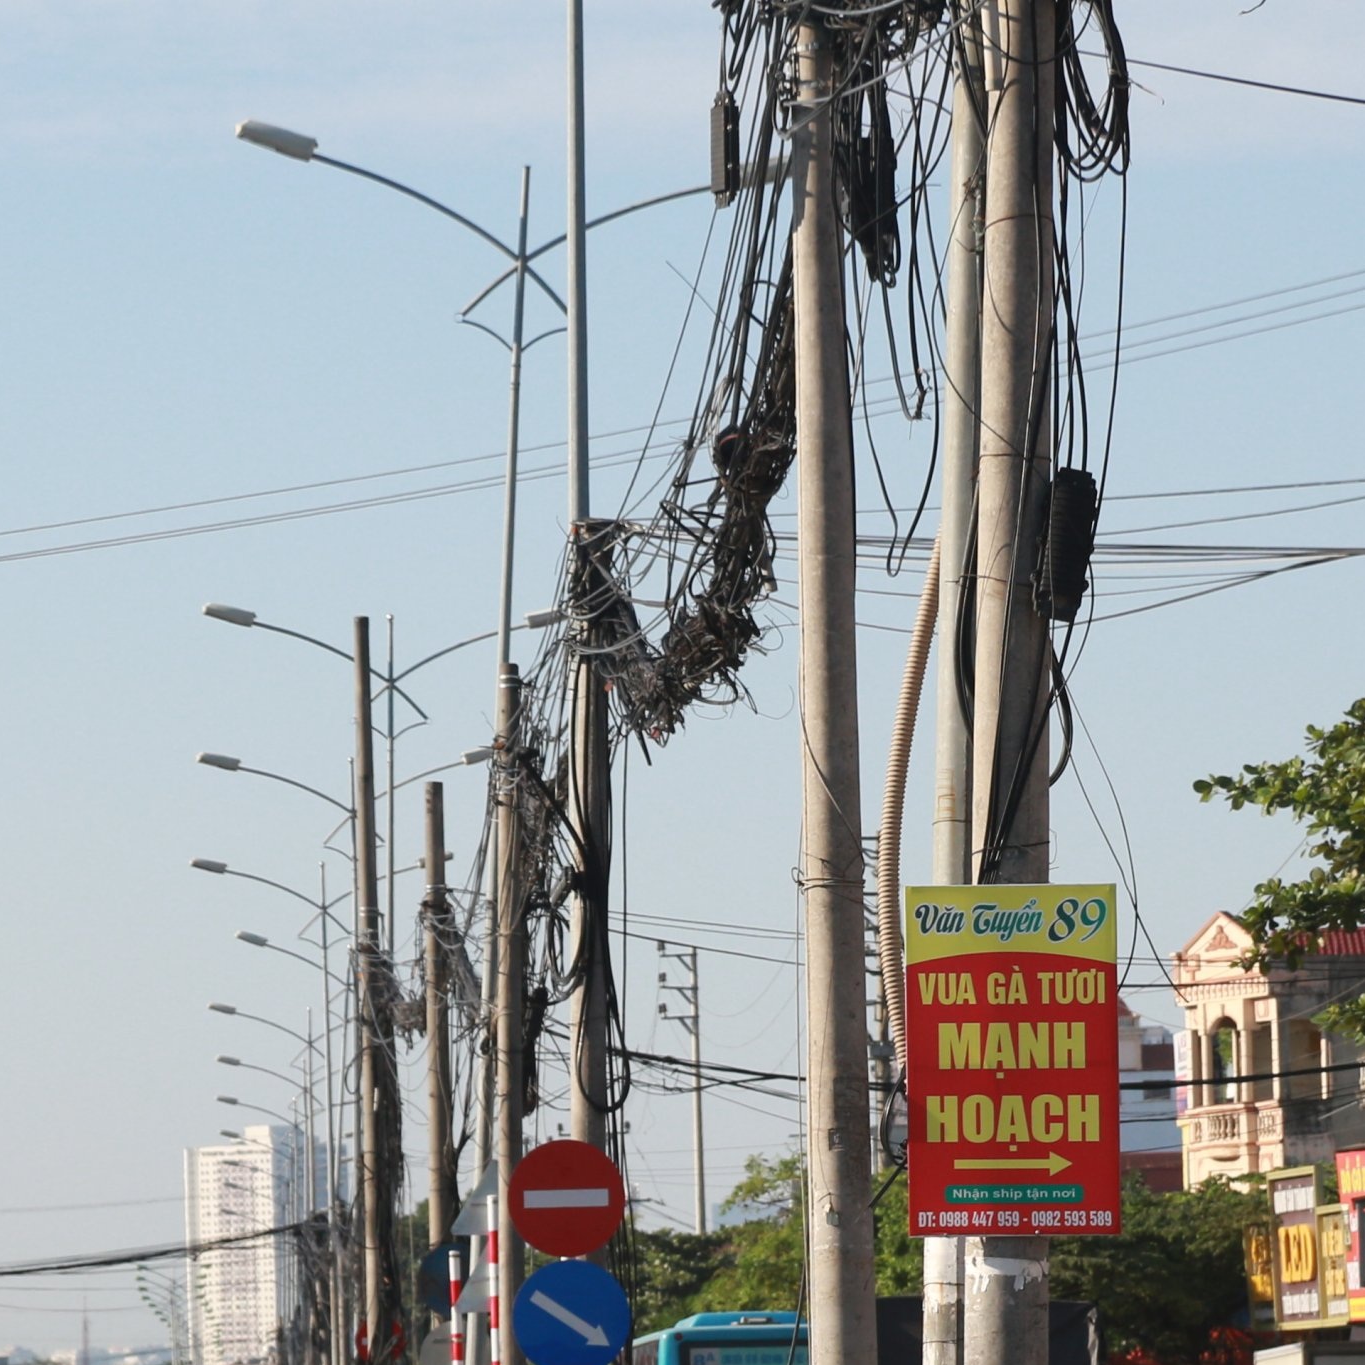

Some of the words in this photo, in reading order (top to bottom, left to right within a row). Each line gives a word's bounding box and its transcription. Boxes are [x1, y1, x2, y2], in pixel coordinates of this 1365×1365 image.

[914, 903, 965, 936] Văn
[971, 898, 1043, 942] Tuyển
[1047, 897, 1108, 943] 89
[918, 972, 976, 1005] VUA
[986, 965, 1031, 1005] GÀ
[1037, 968, 1106, 1005] TƯƠI
[938, 1021, 1086, 1079] MẠNH
[925, 1094, 1100, 1152] HOẠCH
[952, 1187, 989, 1201] Nhận
[992, 1187, 1023, 1202] ship
[1026, 1187, 1049, 1201] tận
[1051, 1187, 1076, 1200] nơi
[918, 1211, 936, 1228] ĐT:
[939, 1211, 969, 1227] 0988
[972, 1211, 994, 1227] 447
[997, 1211, 1020, 1227] 959
[1031, 1210, 1061, 1227] 0982
[1063, 1210, 1087, 1226] 593
[1089, 1210, 1112, 1226] 589
[1278, 1223, 1318, 1284] LED
